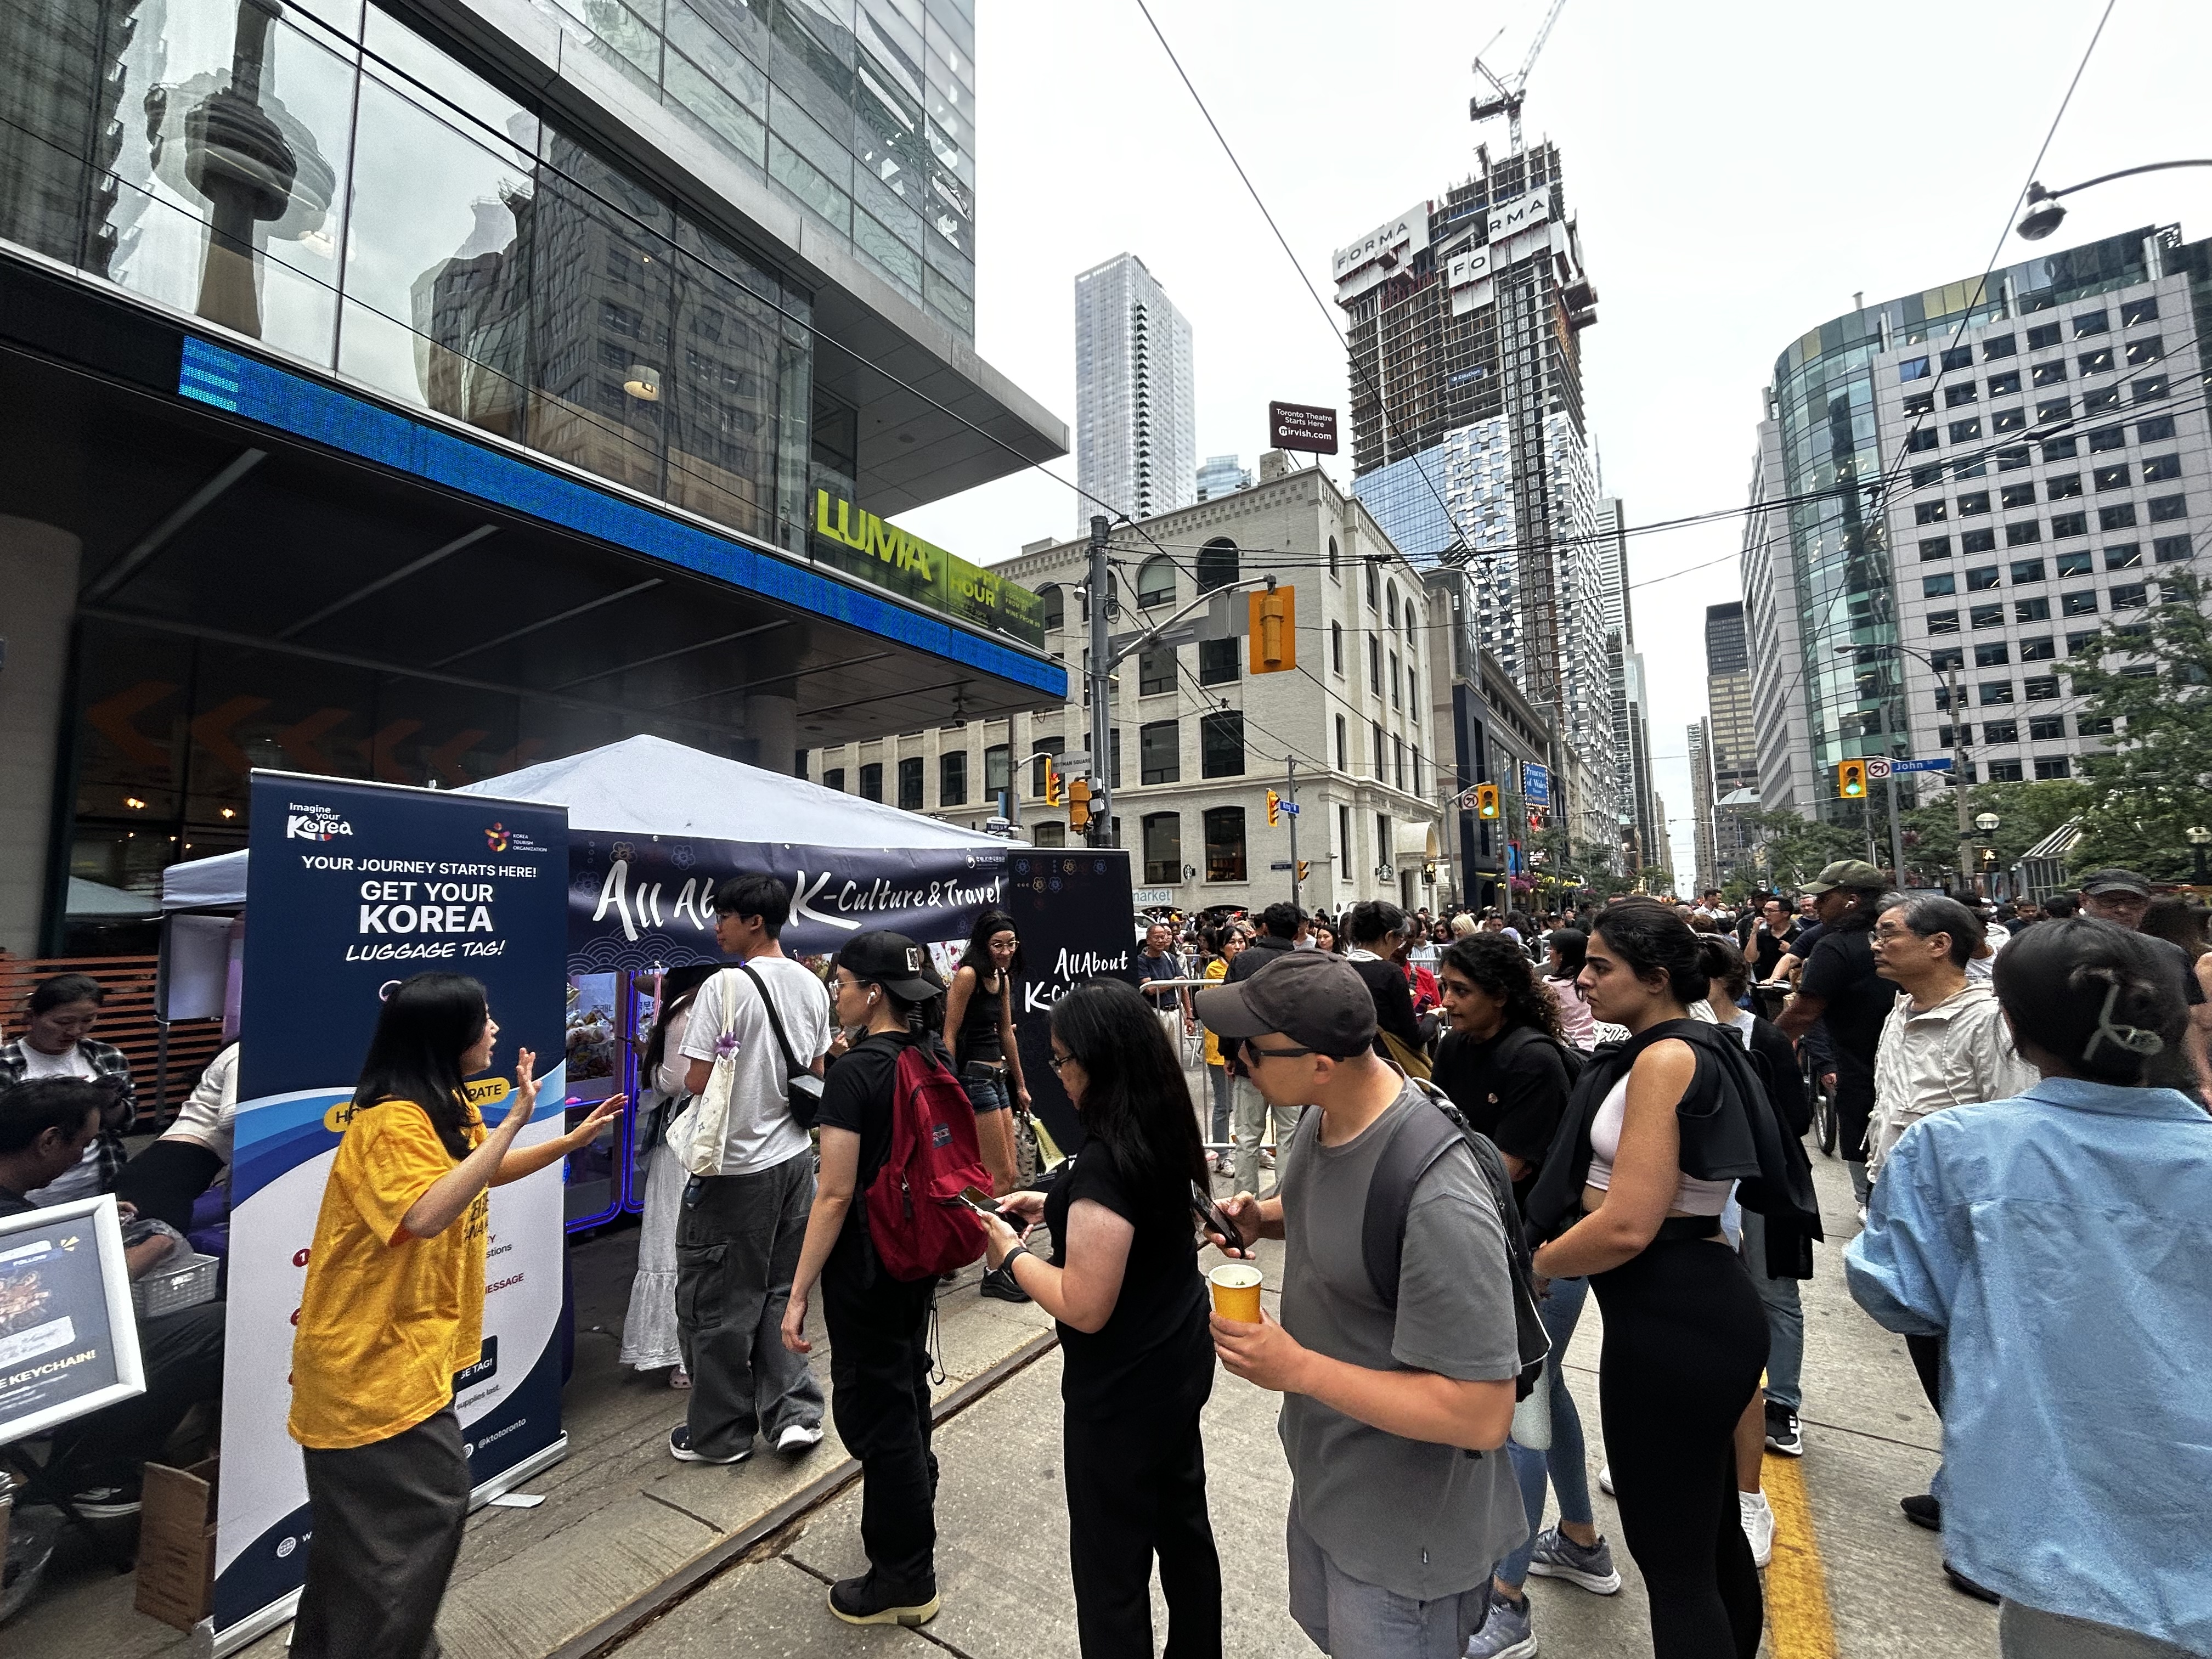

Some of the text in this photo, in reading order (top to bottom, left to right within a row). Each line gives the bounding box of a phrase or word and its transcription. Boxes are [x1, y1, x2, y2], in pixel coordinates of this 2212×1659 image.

[1338, 222, 1408, 269] FORMA
[1276, 408, 1333, 422] Toronto Theatre
[1285, 416, 1324, 428] Starts Here
[1278, 426, 1332, 440] mirvish.com
[817, 488, 932, 582] LUMA
[1005, 608, 1019, 619] WINE
[1019, 613, 1035, 625] FROM
[1526, 766, 1545, 777] Princess
[1895, 761, 1923, 771] John
[1527, 778, 1547, 789] of Wales
[290, 802, 331, 814] Imagine
[315, 812, 341, 821] your
[286, 815, 354, 841] Korea
[302, 856, 537, 878] YOUR JOURNEY STARTS HERE!
[360, 881, 494, 903] GET YOUR
[592, 859, 664, 941] All
[359, 904, 494, 934] KOREA
[345, 939, 506, 962] LUGGAGE TAG!
[300, 1252, 306, 1262] 1
[486, 1243, 512, 1259] stions
[486, 1272, 524, 1294] ESSAGE
[9, 1349, 97, 1386] KEYCHAIN!
[456, 1391, 486, 1410] supplies
[478, 1418, 527, 1448] @ktotoronto
